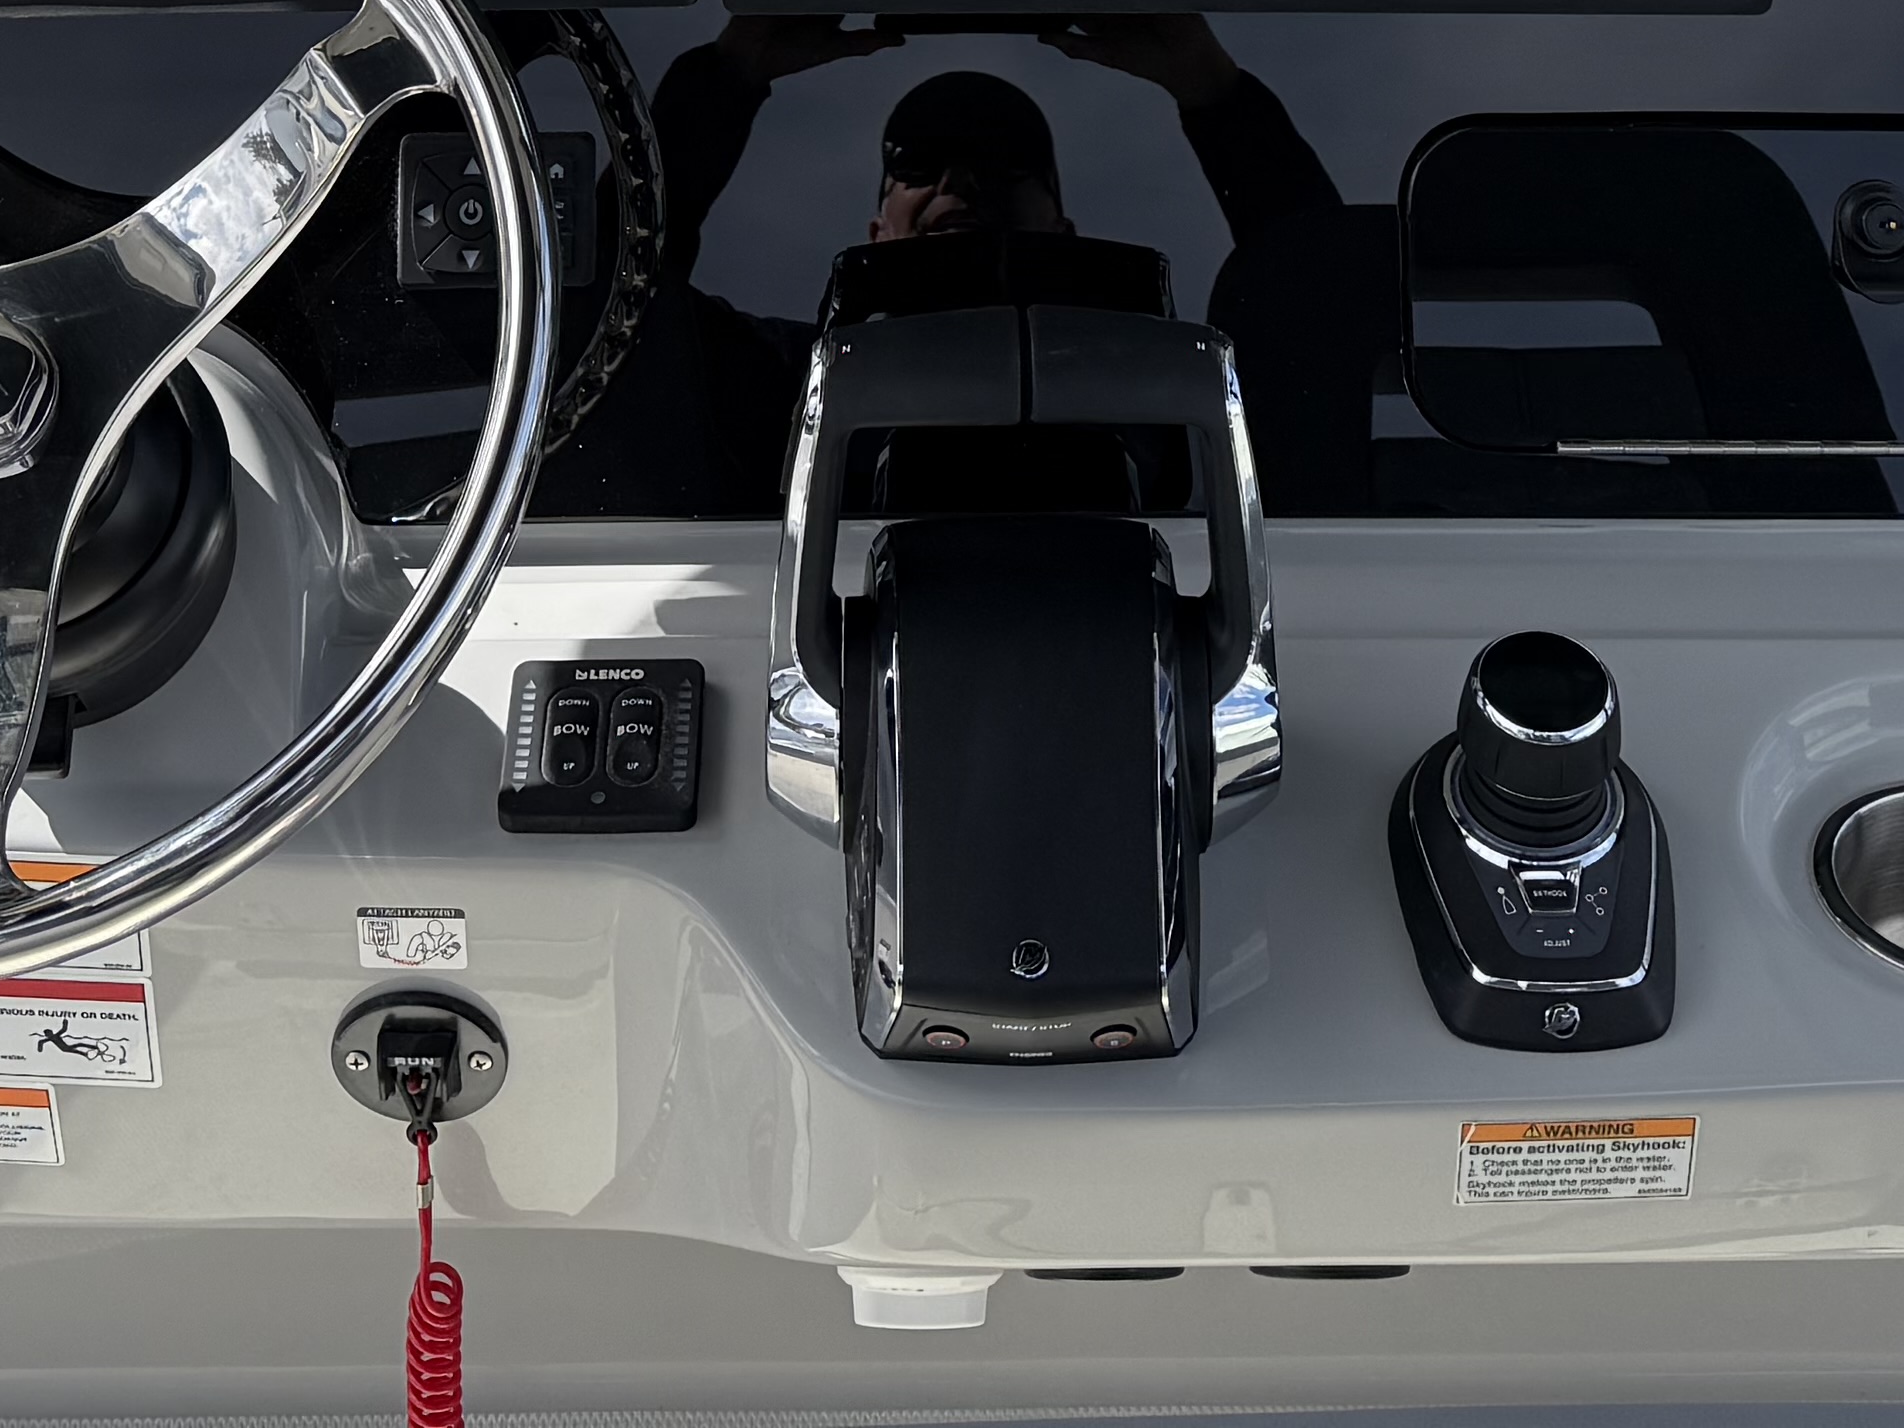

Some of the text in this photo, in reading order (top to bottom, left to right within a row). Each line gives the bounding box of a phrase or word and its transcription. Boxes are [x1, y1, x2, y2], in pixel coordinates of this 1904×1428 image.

[589, 668, 645, 680] LENCO
[558, 698, 590, 707] DOWN
[621, 698, 653, 707] DOWN
[553, 723, 590, 736] BOW
[616, 723, 654, 736] BOW
[563, 762, 575, 771] UP
[627, 762, 639, 770] UP
[80, 1011, 97, 1020] OR
[394, 1057, 434, 1065] RUN
[1544, 1123, 1635, 1137] WARNING
[1469, 1139, 1686, 1155] Before activating Skyhook:
[1482, 1159, 1519, 1168] Check
[1522, 1158, 1543, 1166] that
[1615, 1156, 1633, 1164] the
[1482, 1167, 1502, 1176] Tell
[1506, 1166, 1571, 1177] passengers
[1468, 1180, 1516, 1190] Skyhook
[1560, 1178, 1577, 1186] the
[1468, 1189, 1490, 1197] This
